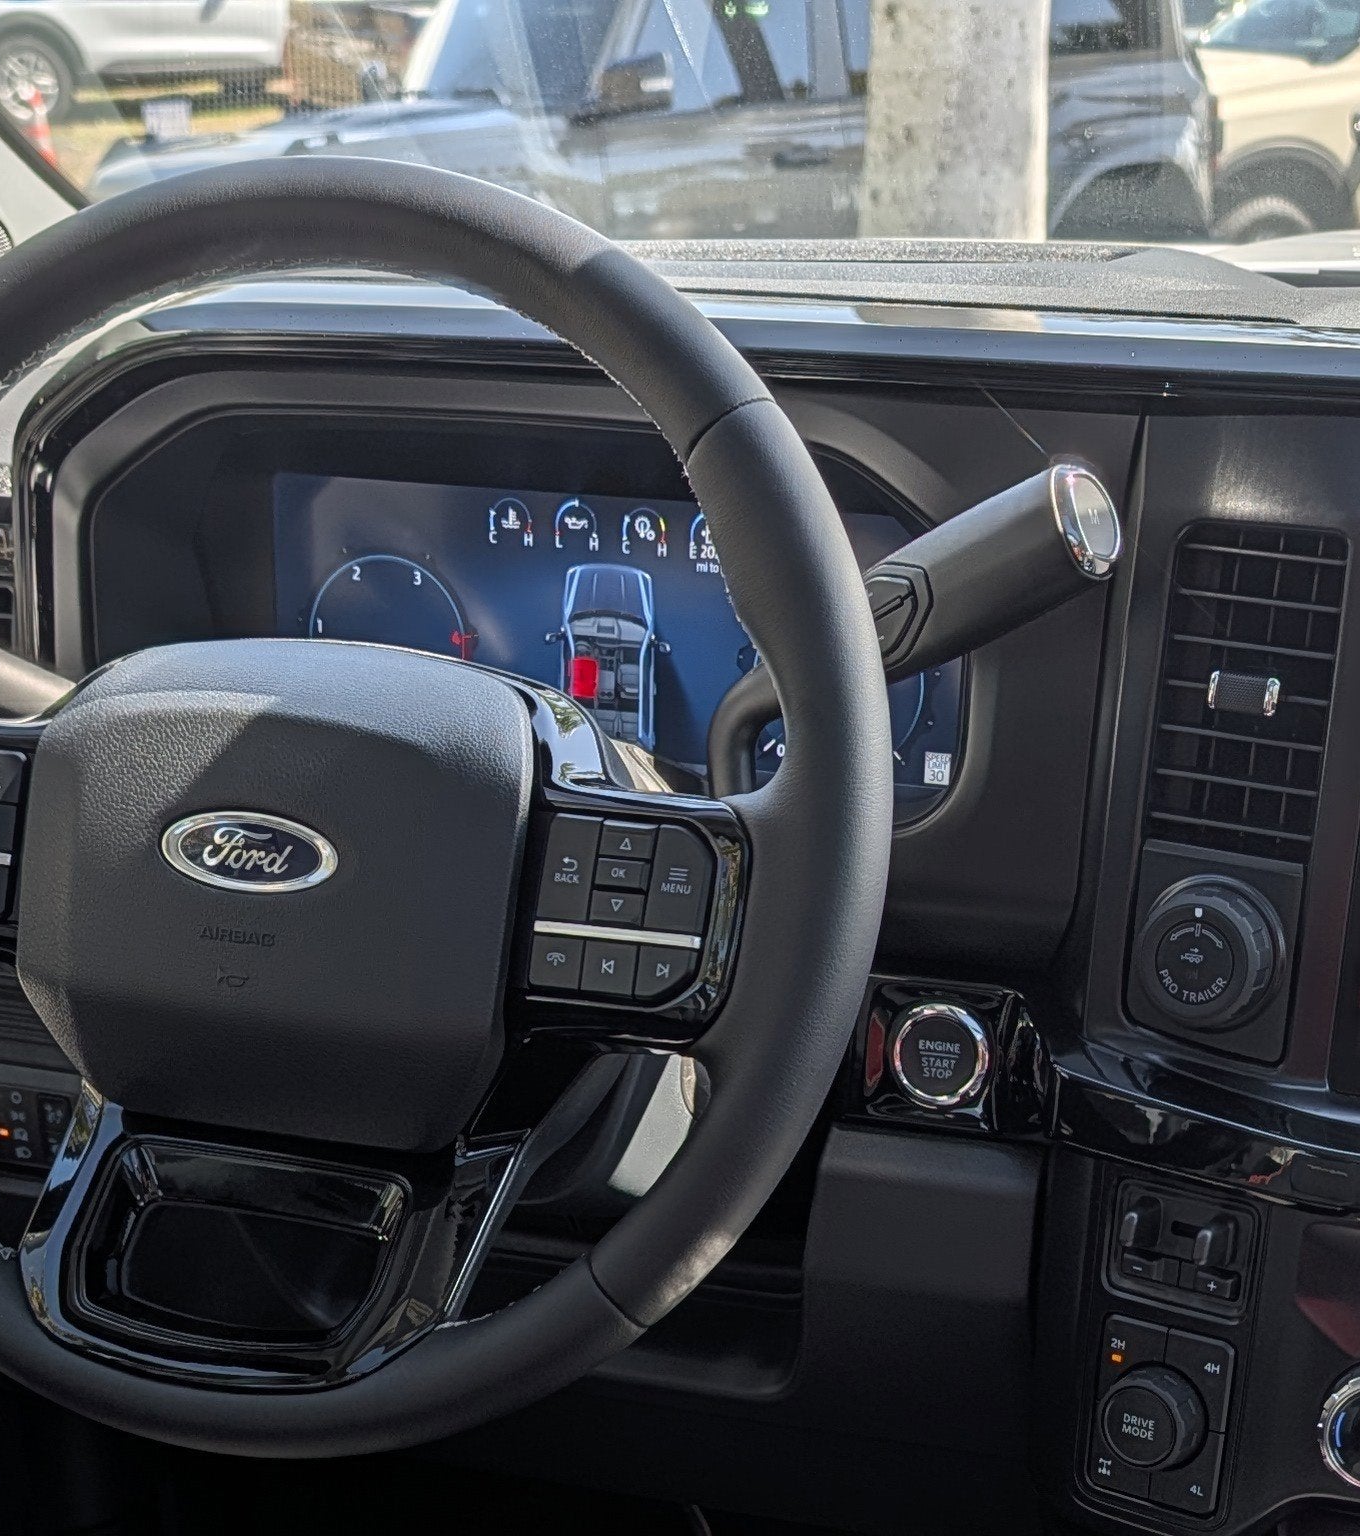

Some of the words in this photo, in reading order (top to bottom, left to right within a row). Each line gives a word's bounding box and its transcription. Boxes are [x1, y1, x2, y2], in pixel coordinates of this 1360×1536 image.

[524, 532, 533, 547] H
[589, 537, 599, 551] H
[657, 543, 668, 557] H
[700, 544, 718, 560] 20
[351, 565, 361, 582] 2
[413, 571, 422, 586] 3
[316, 617, 323, 634] 1
[926, 752, 952, 762] SPEED
[929, 771, 944, 782] 30
[202, 826, 293, 874] Ford
[554, 873, 580, 885] BACK
[611, 867, 626, 879] OK
[660, 882, 692, 895] MENU
[199, 925, 277, 947] AIRBAG
[1158, 968, 1179, 994] PRO
[1182, 977, 1228, 1003] TRAILER
[918, 1039, 961, 1054] ENGINE
[921, 1056, 956, 1070] START
[922, 1067, 953, 1080] STOP
[1110, 1337, 1126, 1350] 2H
[1204, 1361, 1221, 1375] 4H
[1123, 1412, 1155, 1431] DRIVE
[1121, 1423, 1154, 1441] MODE
[1190, 1484, 1204, 1497] 4L
